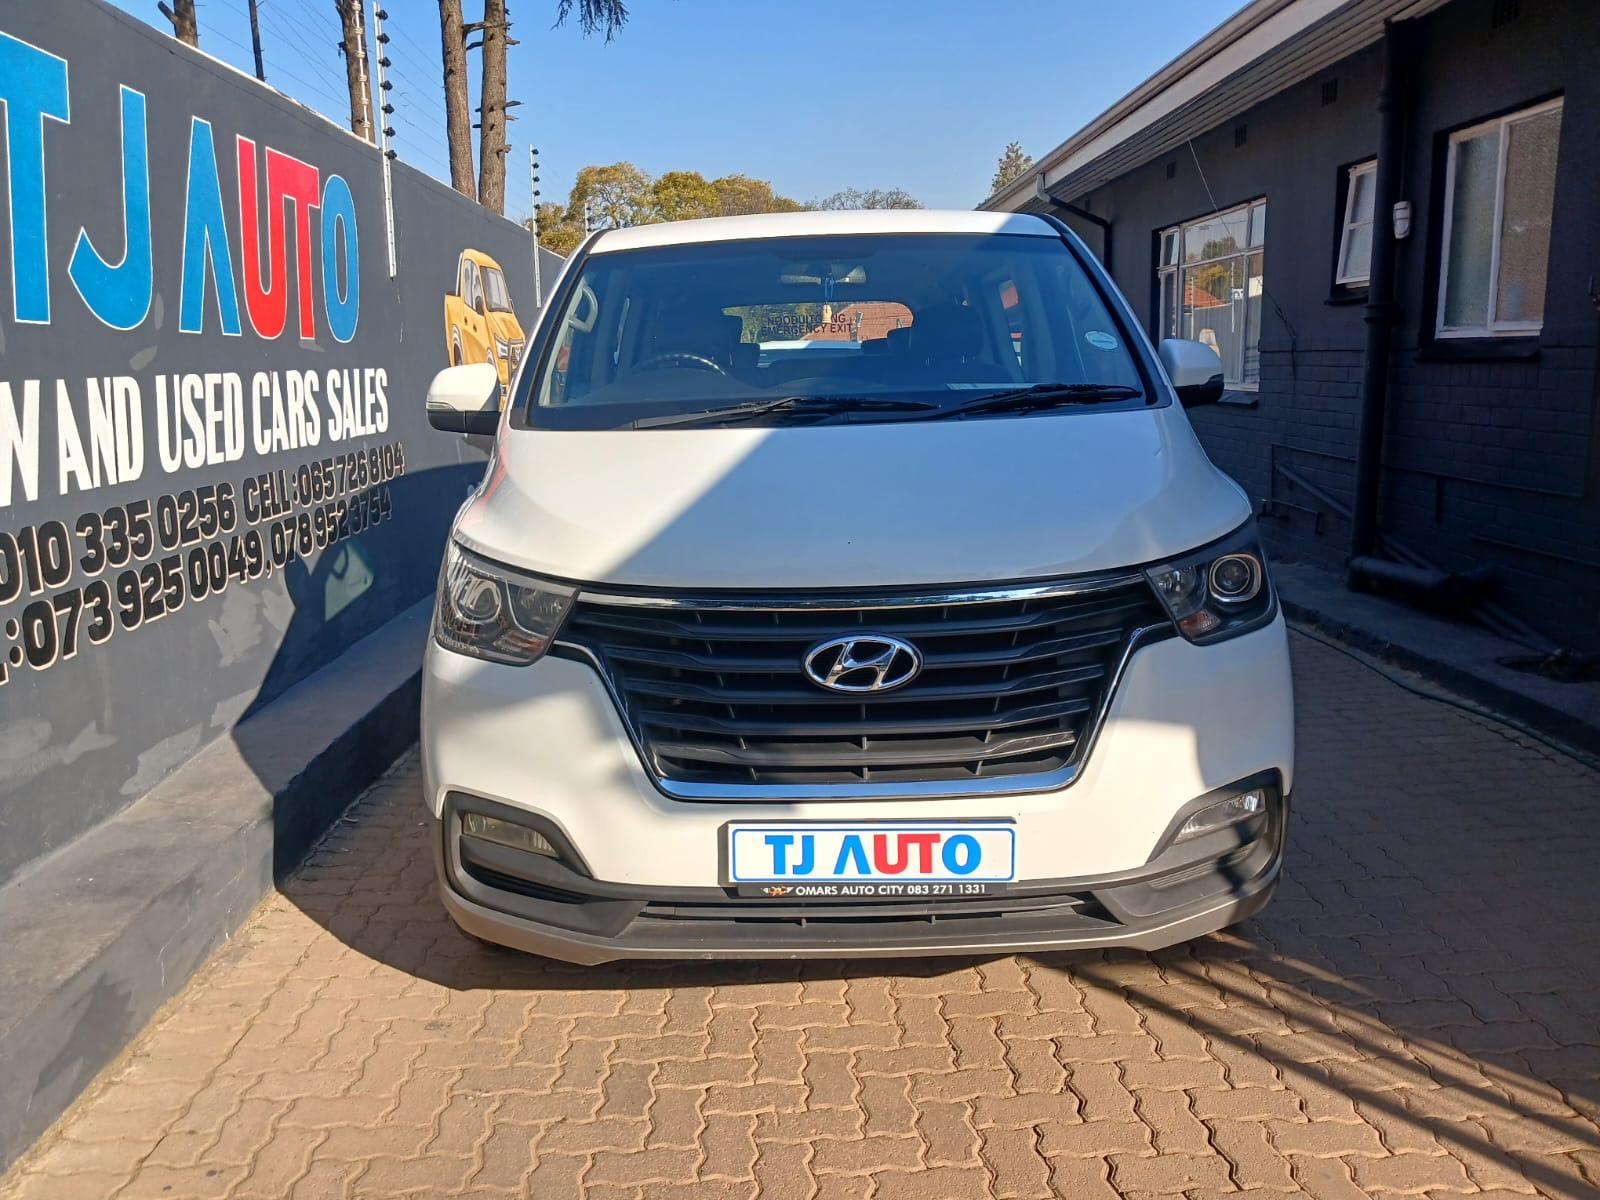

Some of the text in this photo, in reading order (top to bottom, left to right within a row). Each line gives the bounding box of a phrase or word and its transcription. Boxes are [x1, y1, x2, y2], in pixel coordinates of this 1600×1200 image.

[0, 31, 360, 343] TJ AUTO
[762, 322, 853, 335] EMERGENCY EXIT
[768, 314, 845, 325] NOODUITGNG
[57, 375, 145, 495] AND
[155, 372, 245, 473] USED
[251, 369, 321, 455] CARS
[326, 368, 389, 442] SALES
[75, 499, 154, 577] 335
[156, 482, 237, 552] 0256
[117, 554, 187, 632] 925
[764, 833, 982, 875] TJ AUTO
[795, 884, 986, 896] OMARS AUTO CITY 083 271 1331
